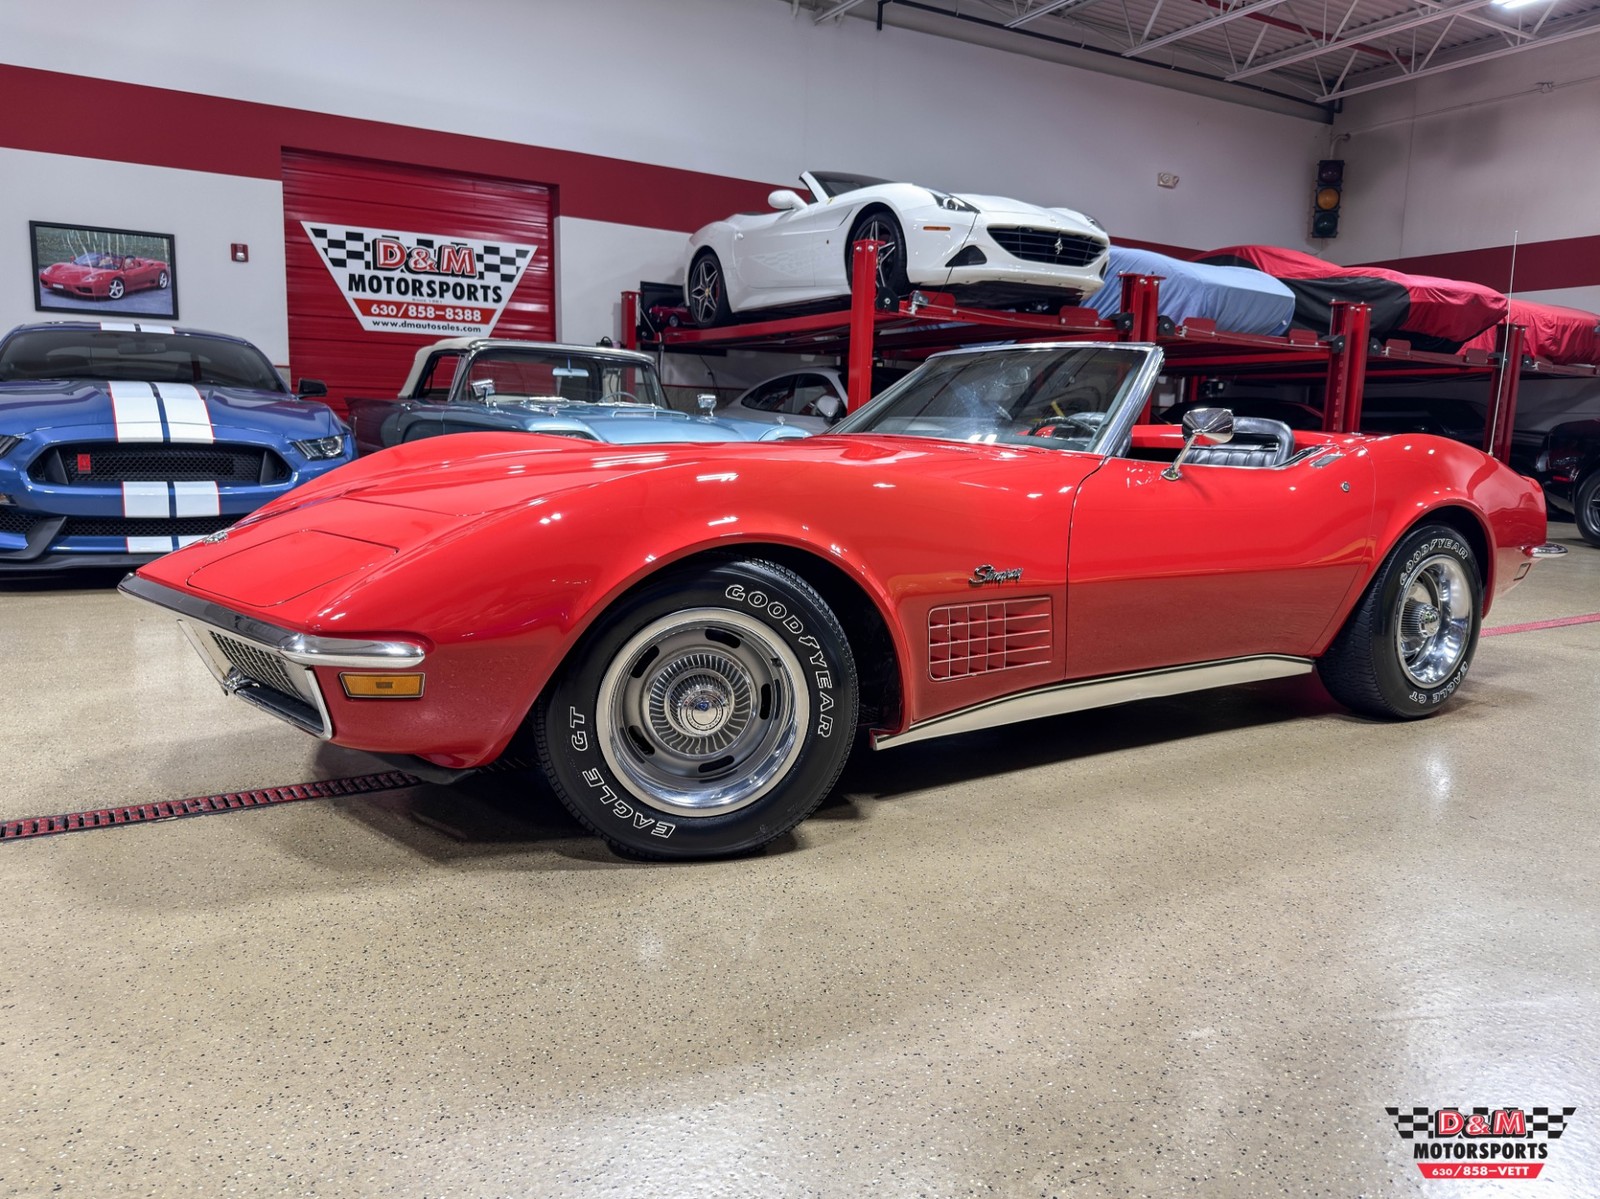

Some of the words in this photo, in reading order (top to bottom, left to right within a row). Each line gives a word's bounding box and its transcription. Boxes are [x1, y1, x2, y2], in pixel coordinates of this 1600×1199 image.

[372, 238, 477, 278] D&M
[348, 273, 503, 303] MOTORSPORTS
[371, 303, 482, 321] 630/858-8388
[372, 320, 481, 333] www.dmautosales.com
[1400, 538, 1469, 586] GOODYEAR
[725, 584, 834, 739] GOODYEAR
[1409, 690, 1427, 704] GT
[1432, 661, 1469, 704] EAGLE
[569, 706, 588, 752] GT
[582, 767, 676, 839] EAGLE
